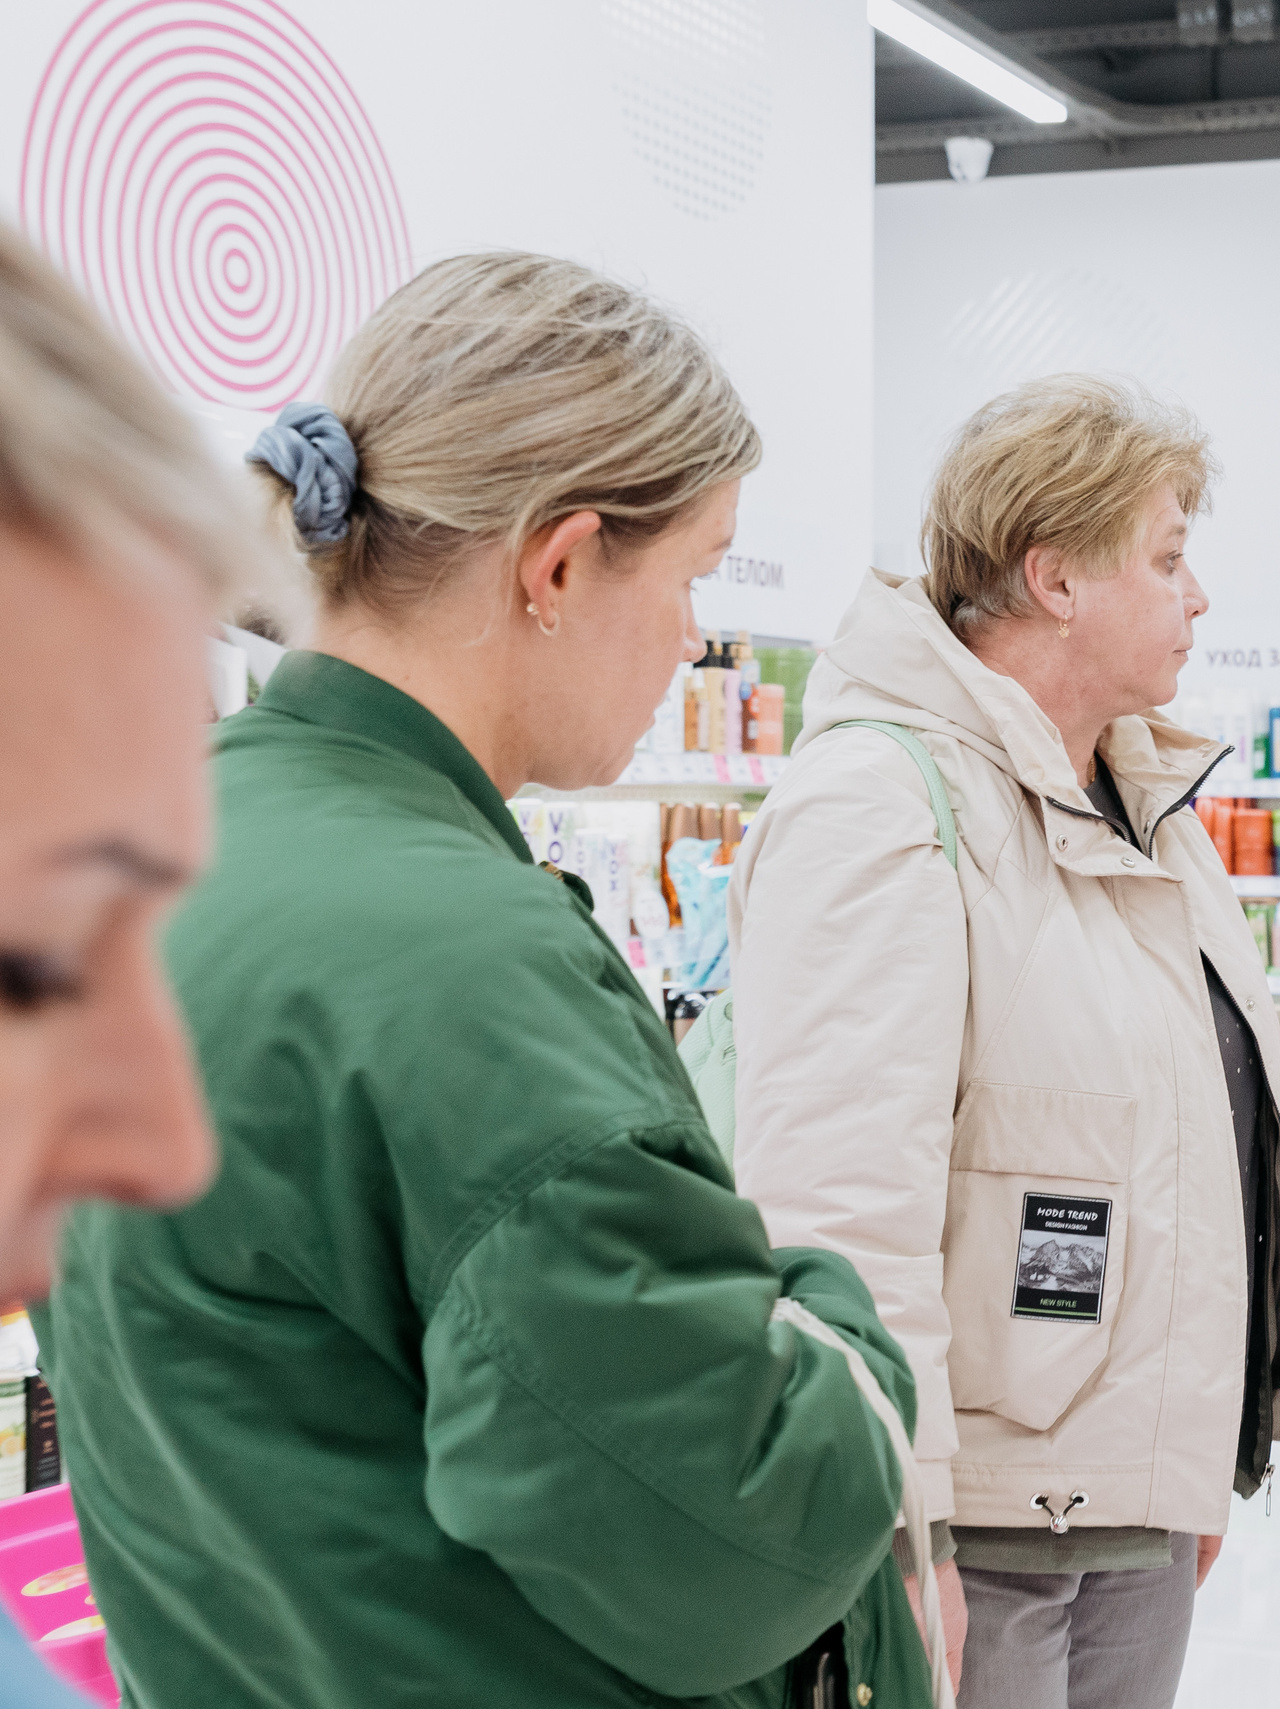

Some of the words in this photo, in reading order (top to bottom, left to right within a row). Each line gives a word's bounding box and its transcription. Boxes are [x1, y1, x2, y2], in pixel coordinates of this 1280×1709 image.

[727, 556, 785, 589] ТЕЛОМ
[1206, 649, 1262, 668] УХОД
[1036, 1207, 1065, 1218] MODE
[1067, 1210, 1098, 1221] TREND
[1040, 1298, 1056, 1306] NEW
[1056, 1300, 1077, 1308] STYLE
